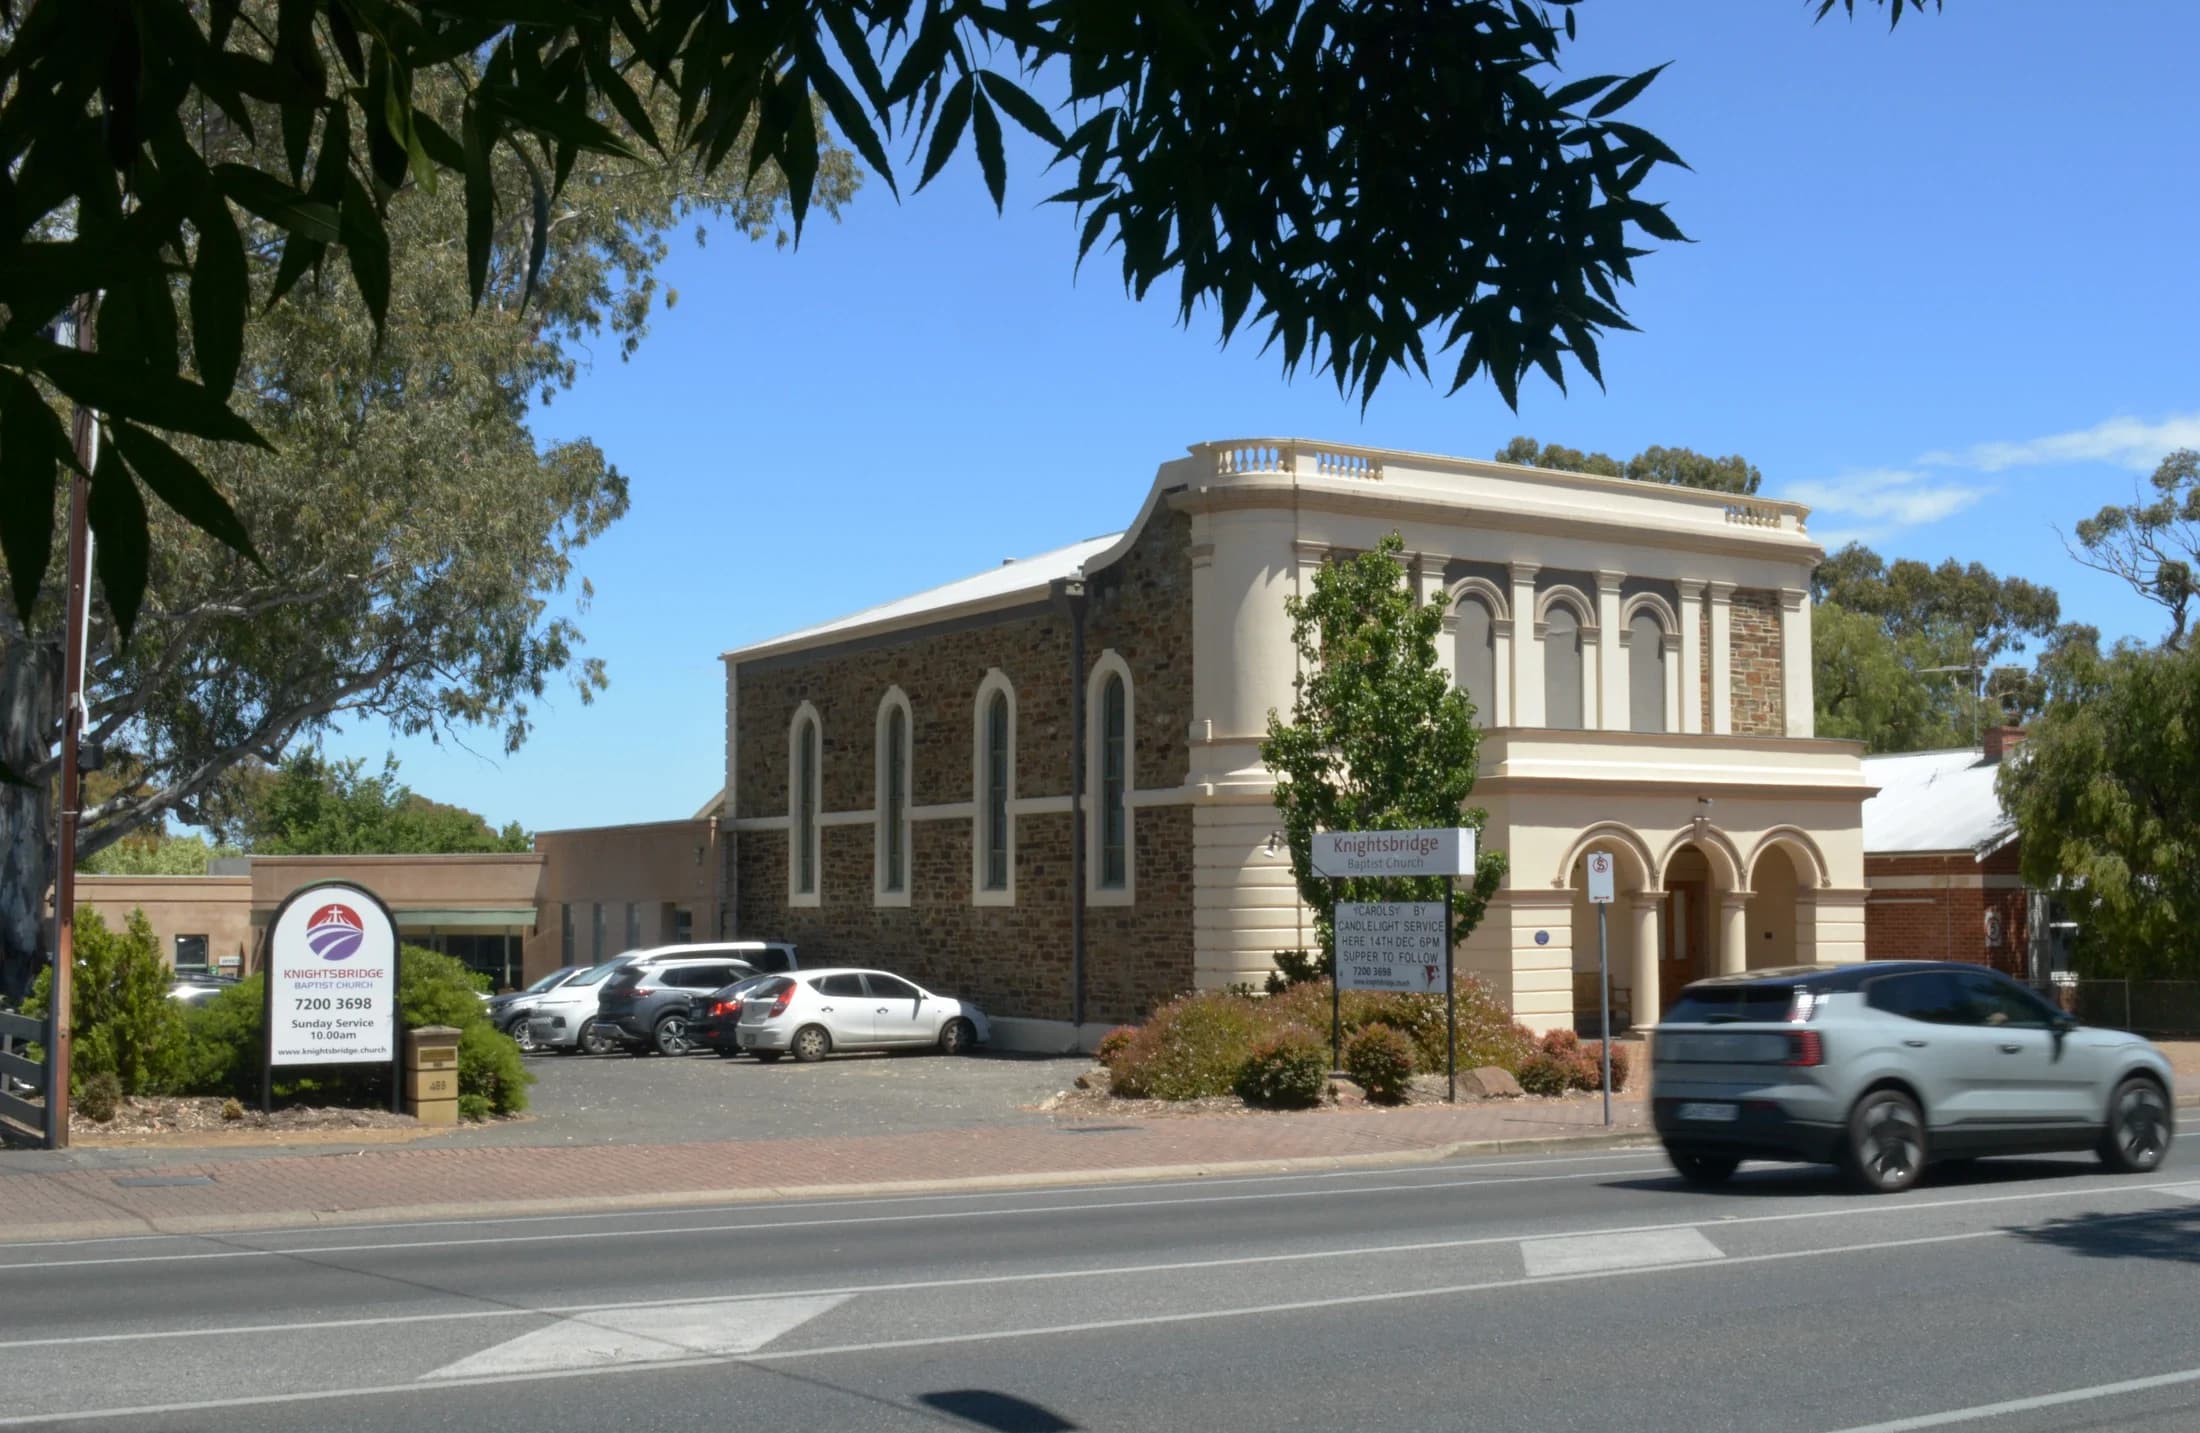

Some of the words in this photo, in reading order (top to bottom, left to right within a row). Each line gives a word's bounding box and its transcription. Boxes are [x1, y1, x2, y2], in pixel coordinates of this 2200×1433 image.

[1334, 833, 1439, 857] Knightsbridge
[1347, 858, 1382, 871] Baptist
[1386, 857, 1424, 869] Church
[1413, 905, 1426, 916] BY
[1338, 921, 1399, 932] CANDLELIGHT
[1403, 921, 1444, 932] SERVICE
[1342, 936, 1365, 946] HERE
[1370, 936, 1393, 947] 14TH
[1395, 937, 1414, 947] DEC
[1419, 937, 1440, 948] 6PM
[1343, 951, 1378, 962] SUPPER
[1382, 951, 1394, 962] TO
[1399, 952, 1438, 964] FOLLOW
[283, 969, 384, 979] KNIGHTSBRIDGE
[1353, 966, 1371, 976] 7200
[1373, 967, 1392, 977] 3698
[294, 981, 333, 990] BAPTIST
[336, 981, 373, 989] CHURCH
[295, 998, 331, 1010] 7200
[335, 998, 372, 1010] 3698
[291, 1019, 333, 1030] Sunday
[335, 1018, 374, 1028] Service
[311, 1031, 357, 1040] 10.00am
[278, 1046, 387, 1056] www.knightsbridge.church
